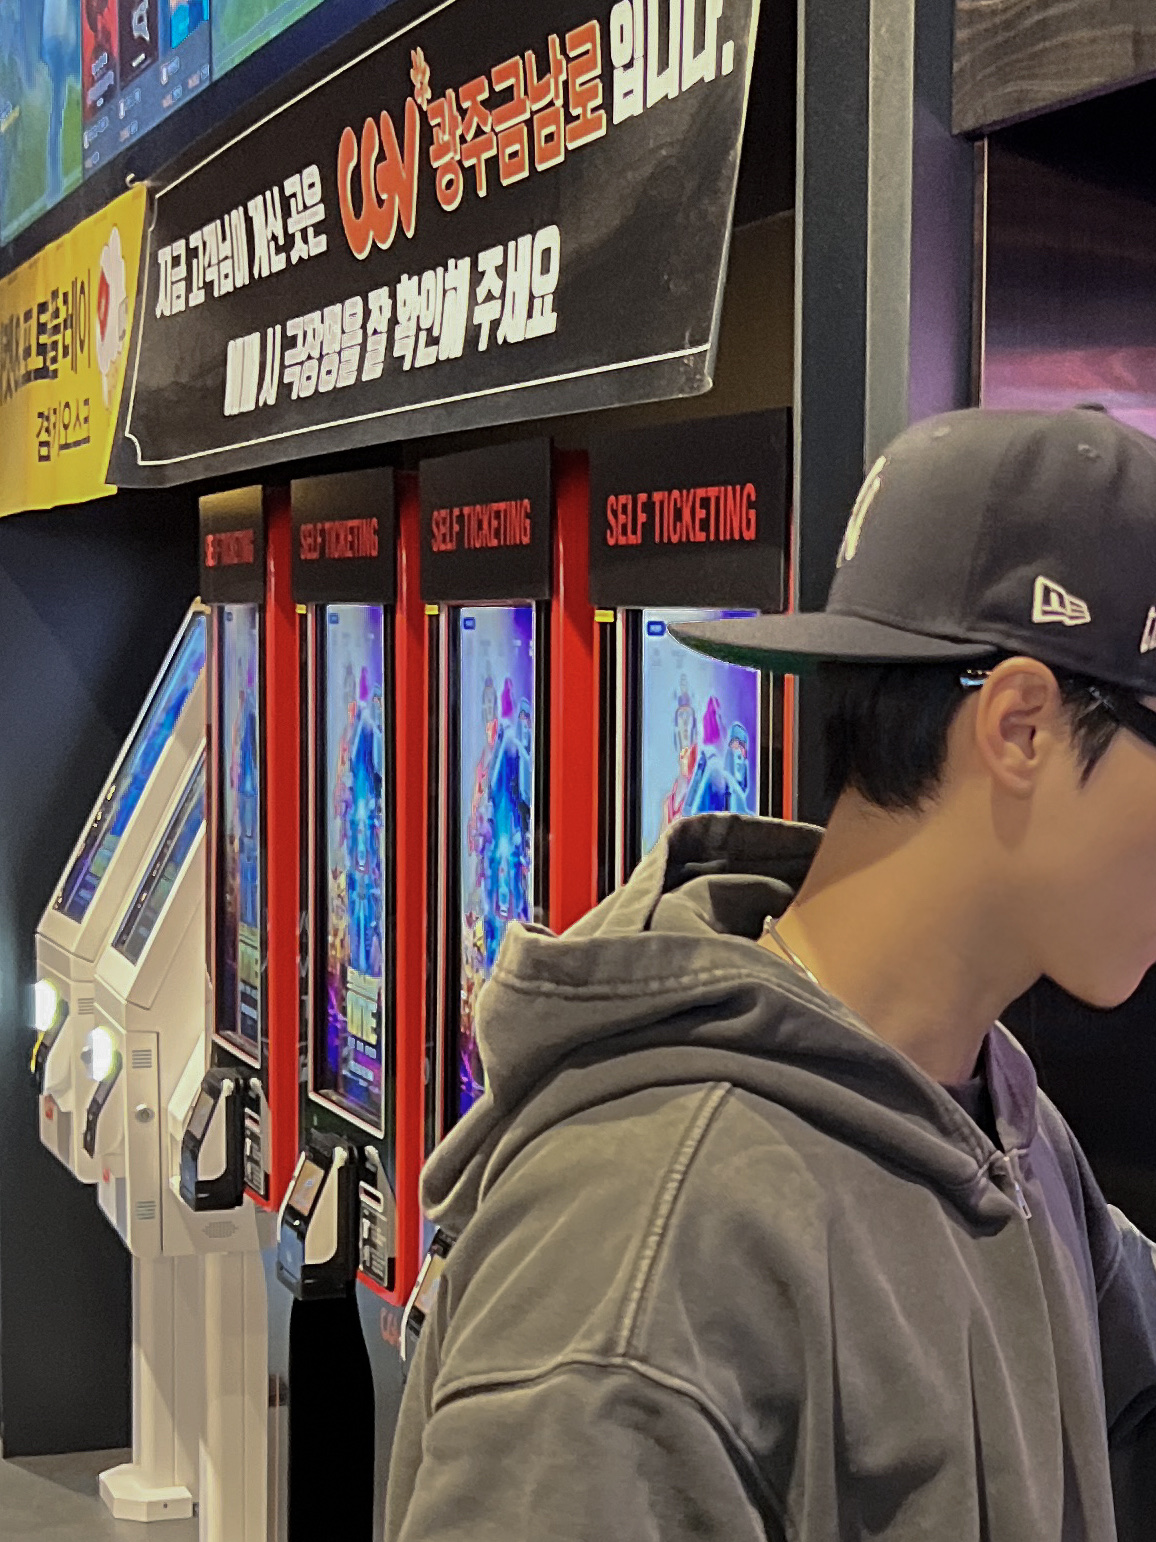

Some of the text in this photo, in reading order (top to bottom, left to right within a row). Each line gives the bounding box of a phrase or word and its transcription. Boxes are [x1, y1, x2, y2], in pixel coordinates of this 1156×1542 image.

[155, 238, 187, 319] 지금
[188, 205, 250, 307] 고객님이
[247, 186, 286, 280] 계신
[283, 164, 328, 265] 곳은
[337, 97, 420, 260] CGV
[283, 295, 364, 400] 극장명을
[362, 286, 393, 382] 잘
[473, 224, 561, 352] 주세요
[301, 523, 322, 560] SELF
[431, 499, 531, 552] SELF TICKETING
[606, 483, 757, 546] SELF TICKETING
